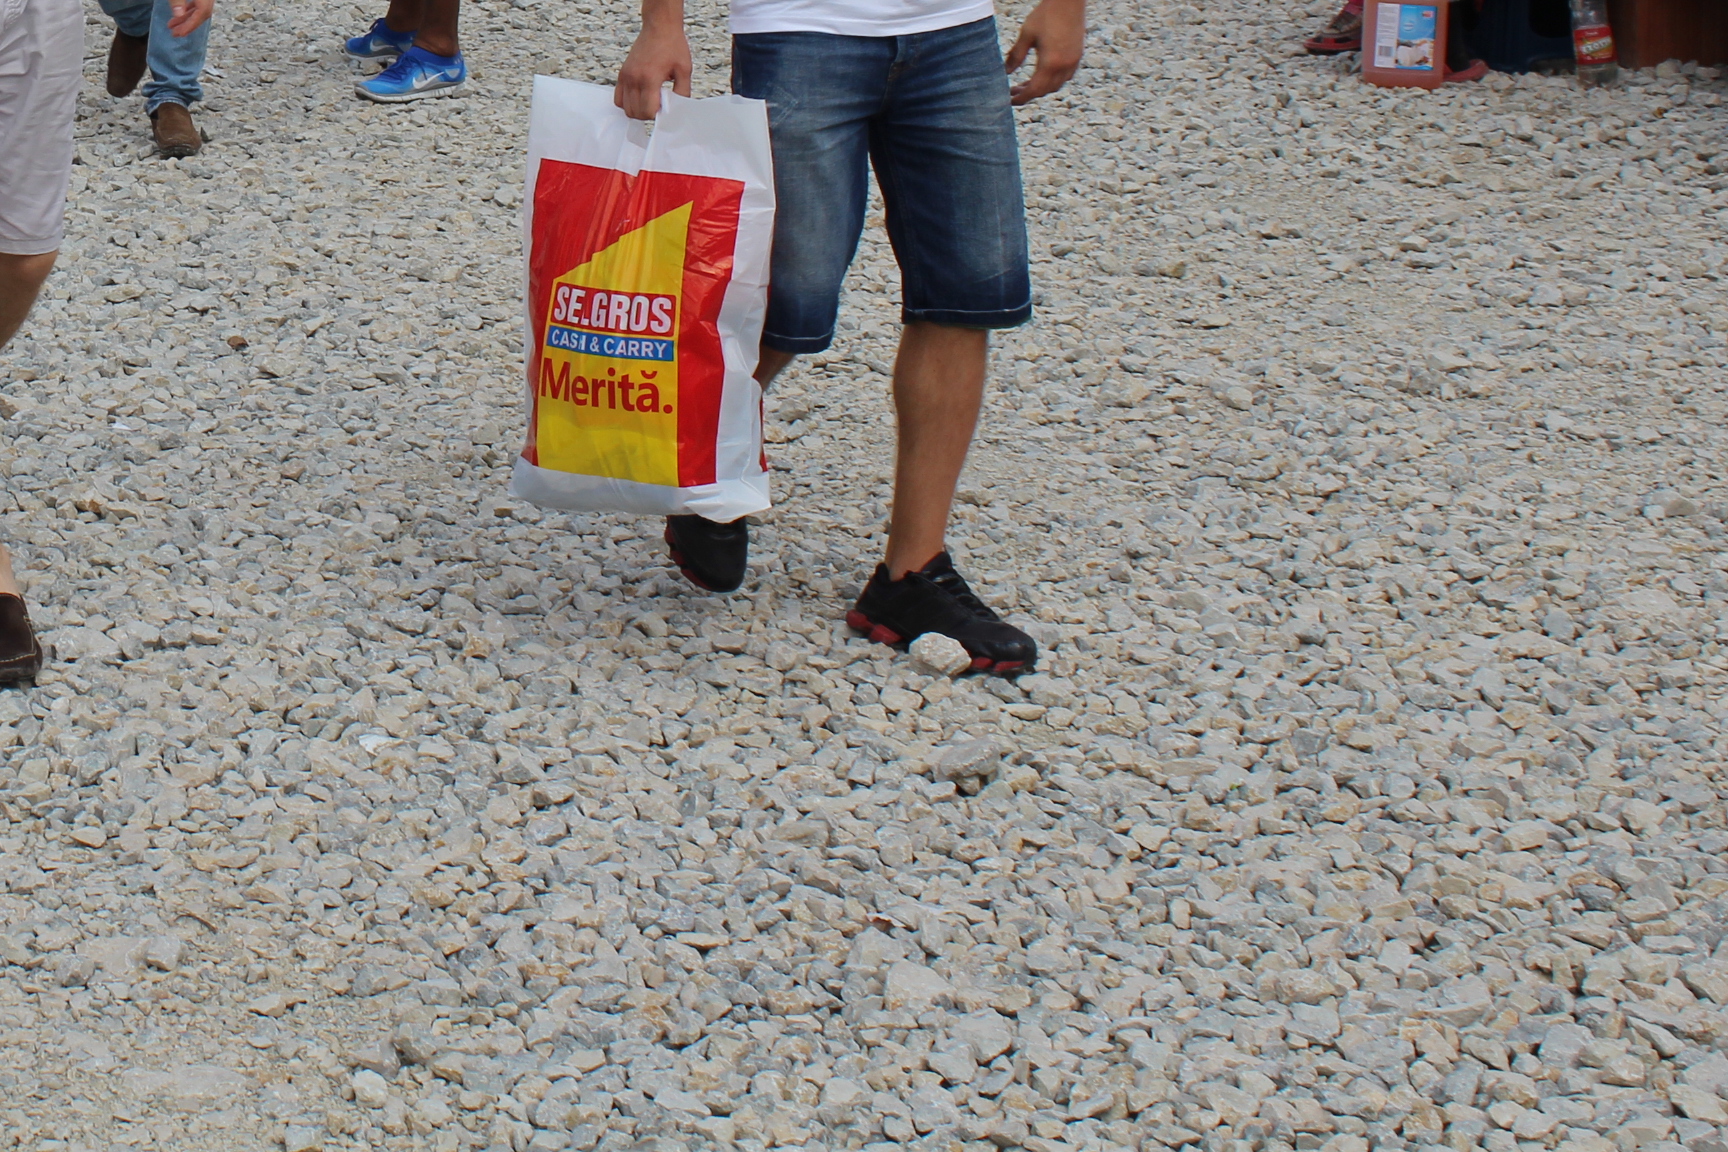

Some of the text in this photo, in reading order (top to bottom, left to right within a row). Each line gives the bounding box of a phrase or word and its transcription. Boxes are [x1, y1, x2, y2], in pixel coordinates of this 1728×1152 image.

[552, 329, 667, 358] CASH & CARRY
[541, 357, 673, 414] Merită.
